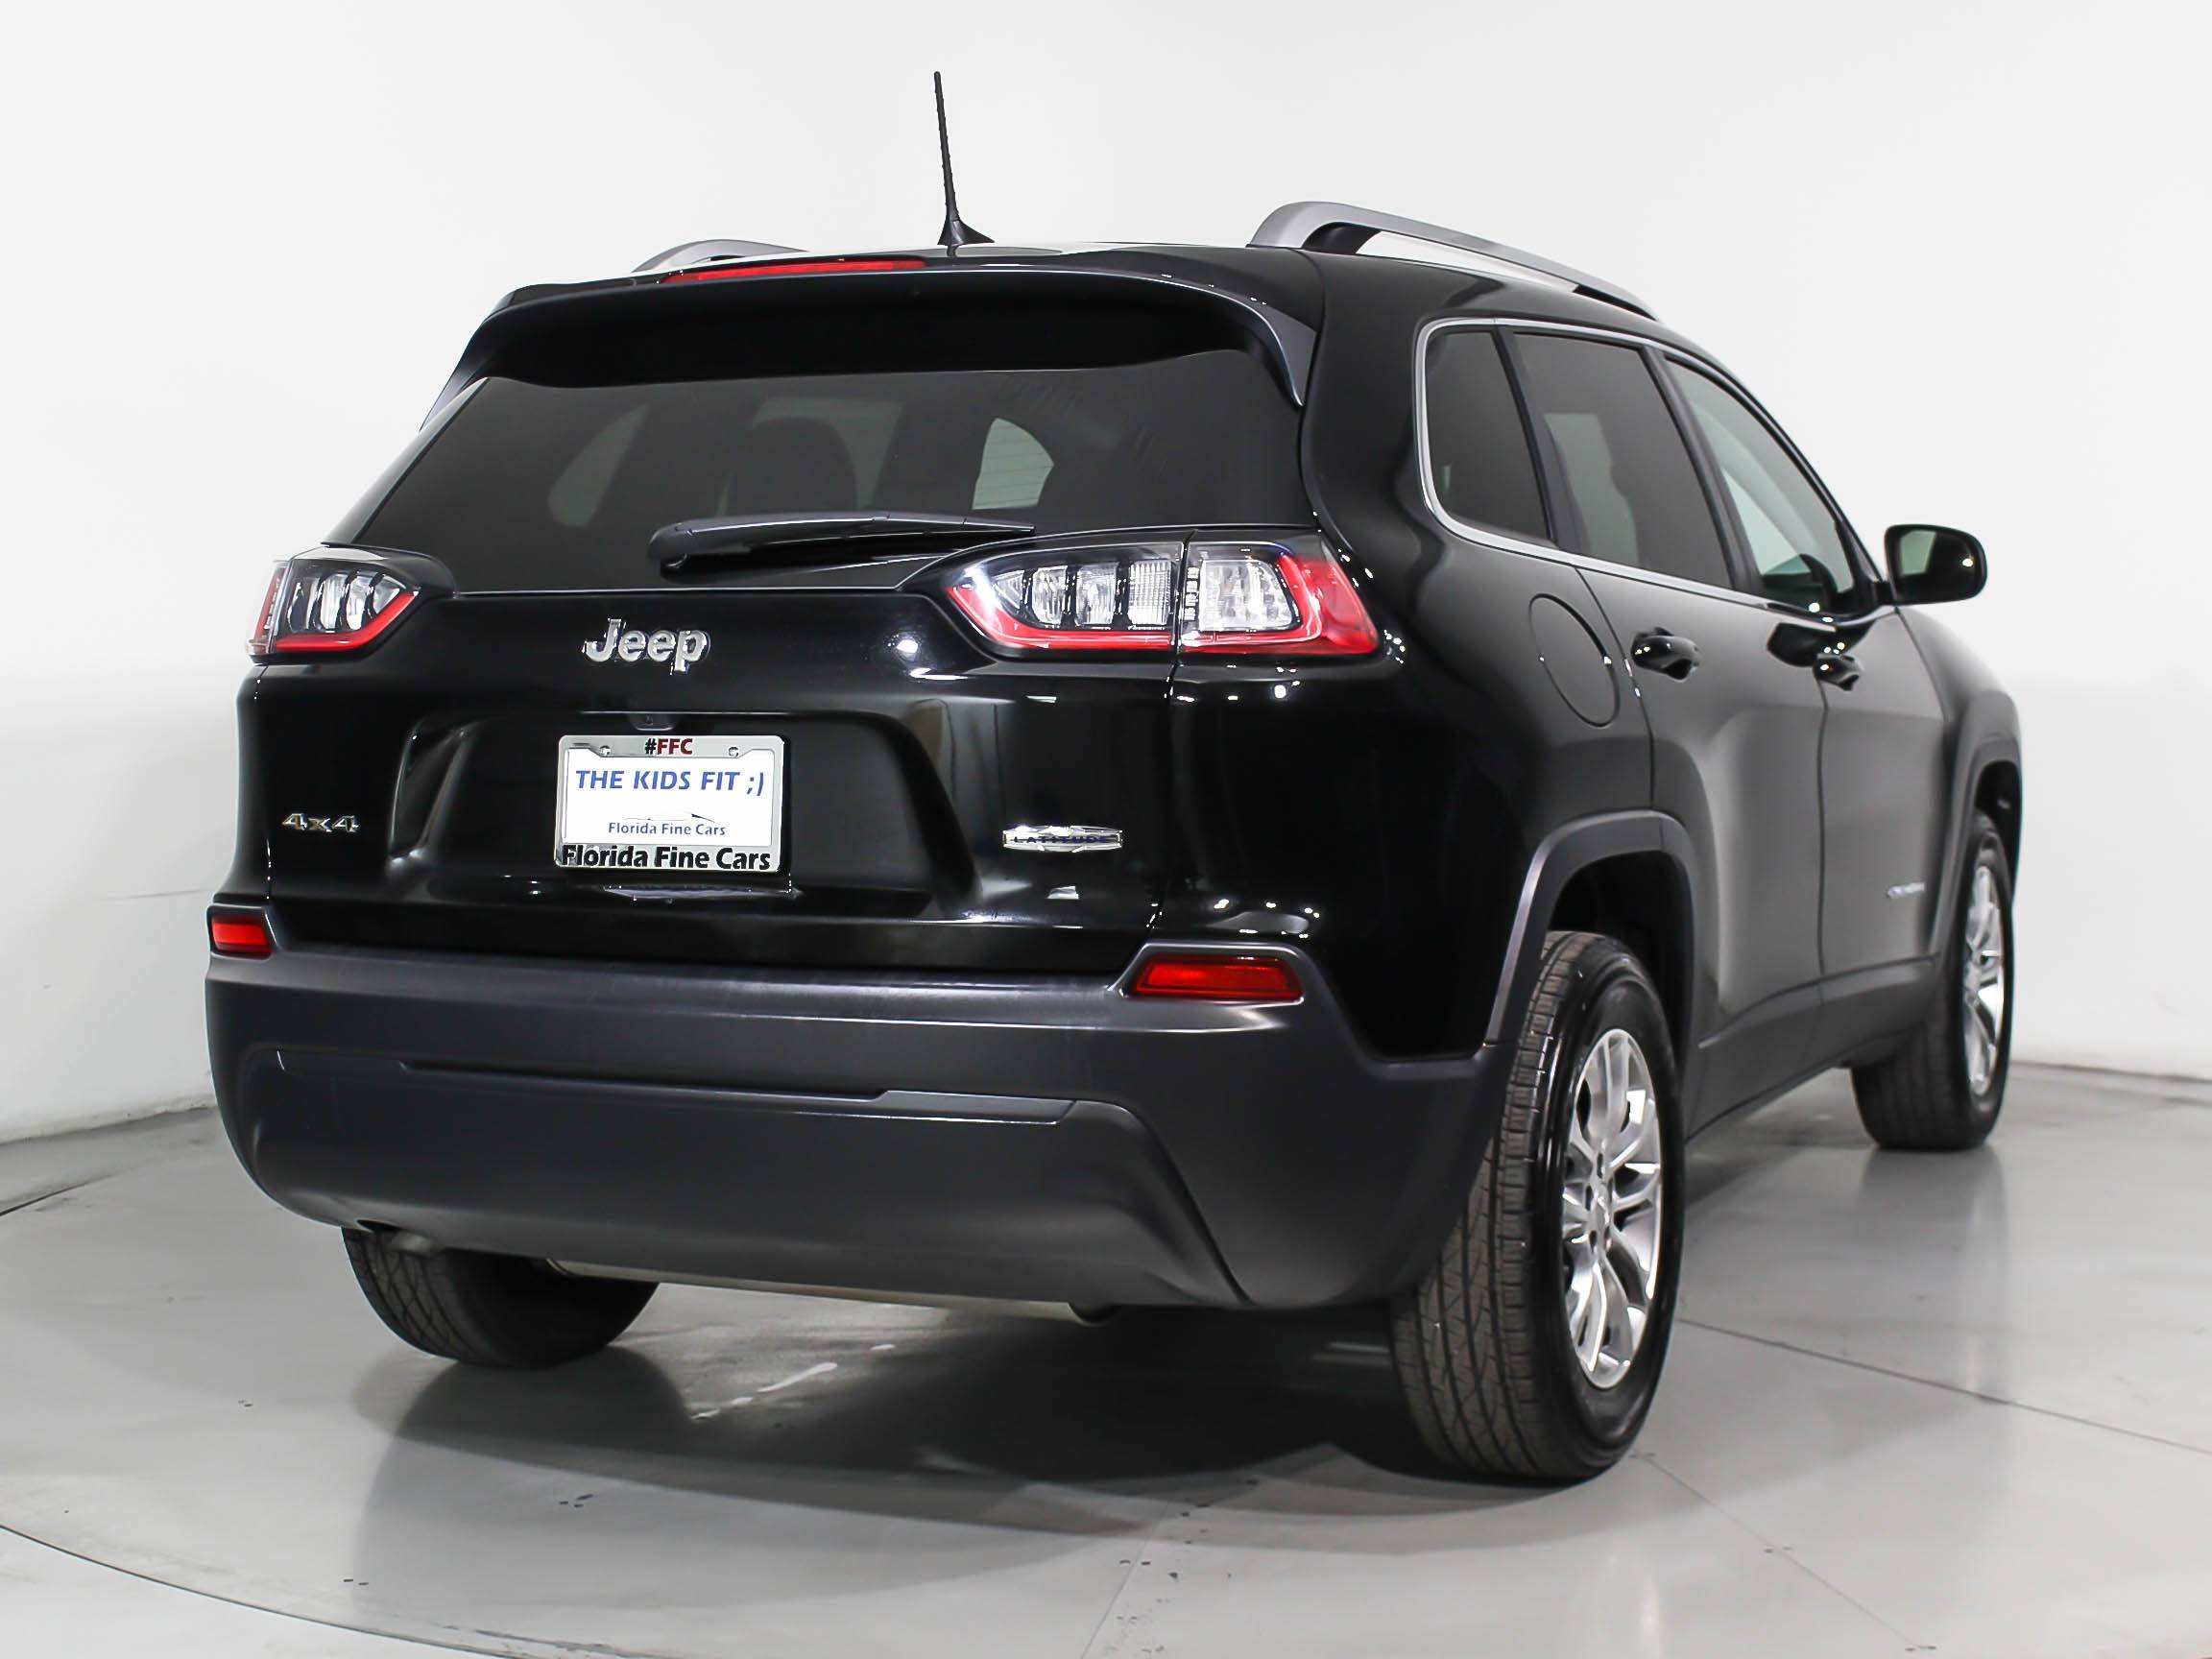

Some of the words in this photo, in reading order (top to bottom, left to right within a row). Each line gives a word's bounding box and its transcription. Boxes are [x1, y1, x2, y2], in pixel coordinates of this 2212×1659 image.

[583, 618, 710, 674] Jeep
[644, 738, 693, 755] #FFC
[576, 770, 624, 789] THE
[633, 771, 690, 790] KIDS
[701, 771, 740, 790] FIT
[609, 822, 657, 834] Florida
[661, 823, 691, 835] Fine
[695, 824, 726, 836] Cars
[562, 845, 648, 868] Florida
[654, 847, 709, 869] Fine
[715, 848, 771, 870] Cars
